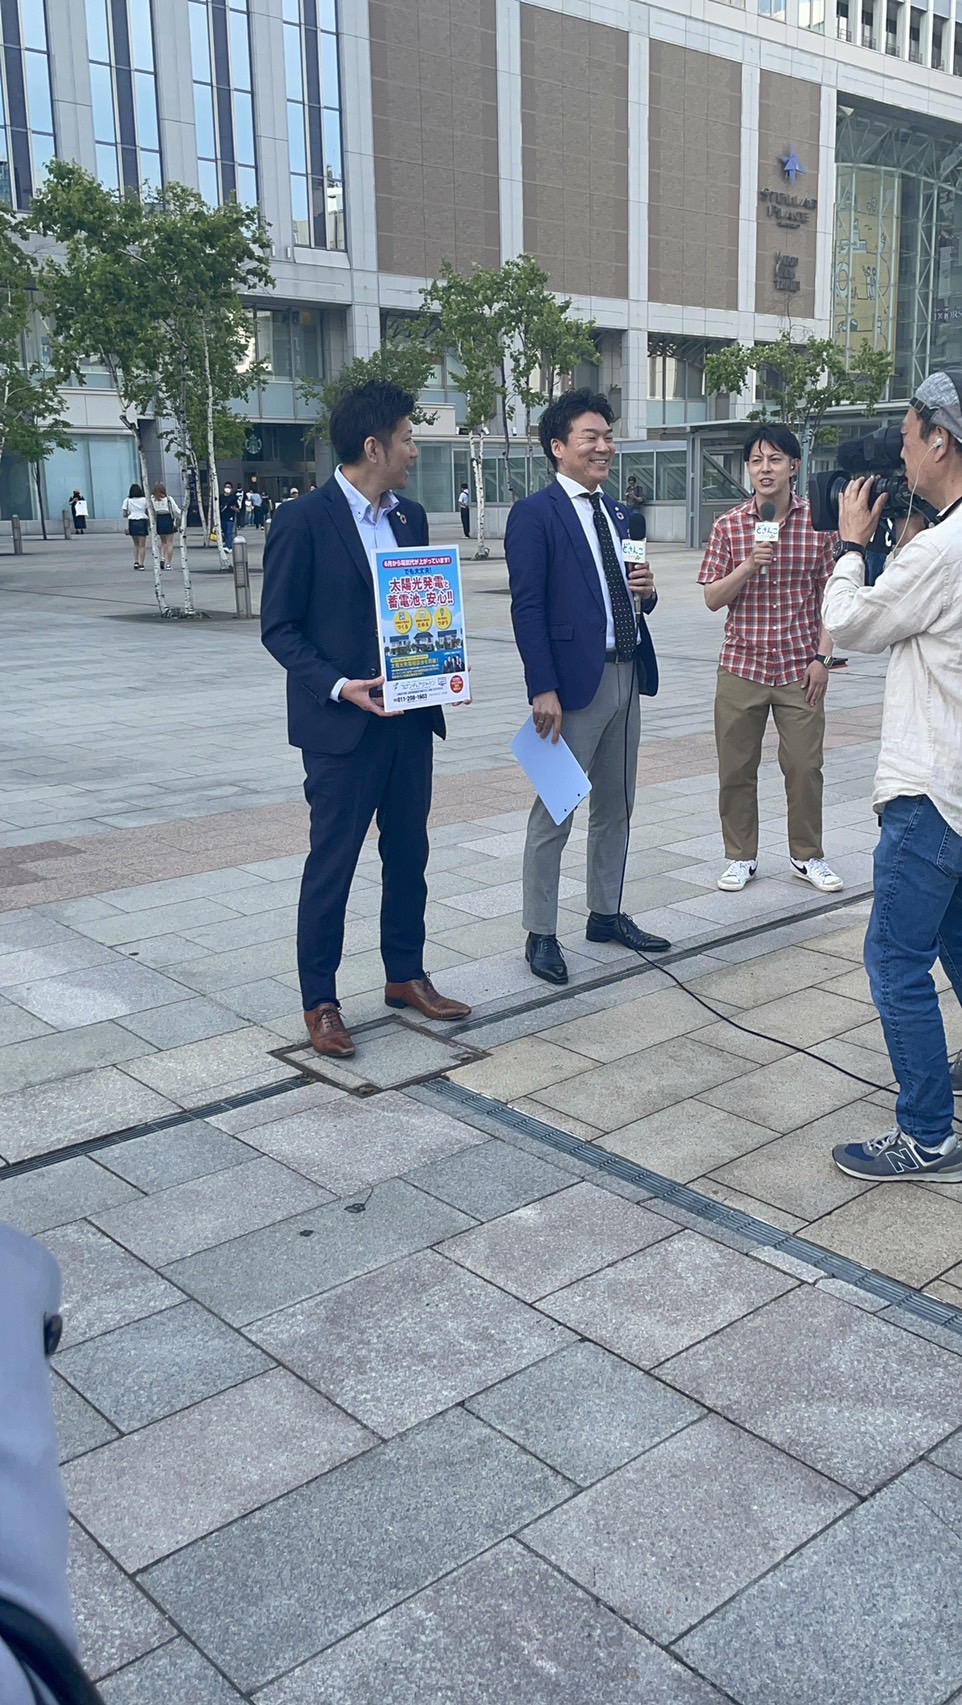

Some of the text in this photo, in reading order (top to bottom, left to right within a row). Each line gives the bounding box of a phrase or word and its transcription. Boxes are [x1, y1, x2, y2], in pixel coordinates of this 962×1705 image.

[767, 205, 811, 224] PLACE
[756, 524, 778, 535] どさんこ
[621, 542, 644, 555] どさんこ
[404, 567, 432, 575] でも大丈夫!
[389, 575, 450, 592] 太陽光発電と
[885, 1147, 919, 1173] N
